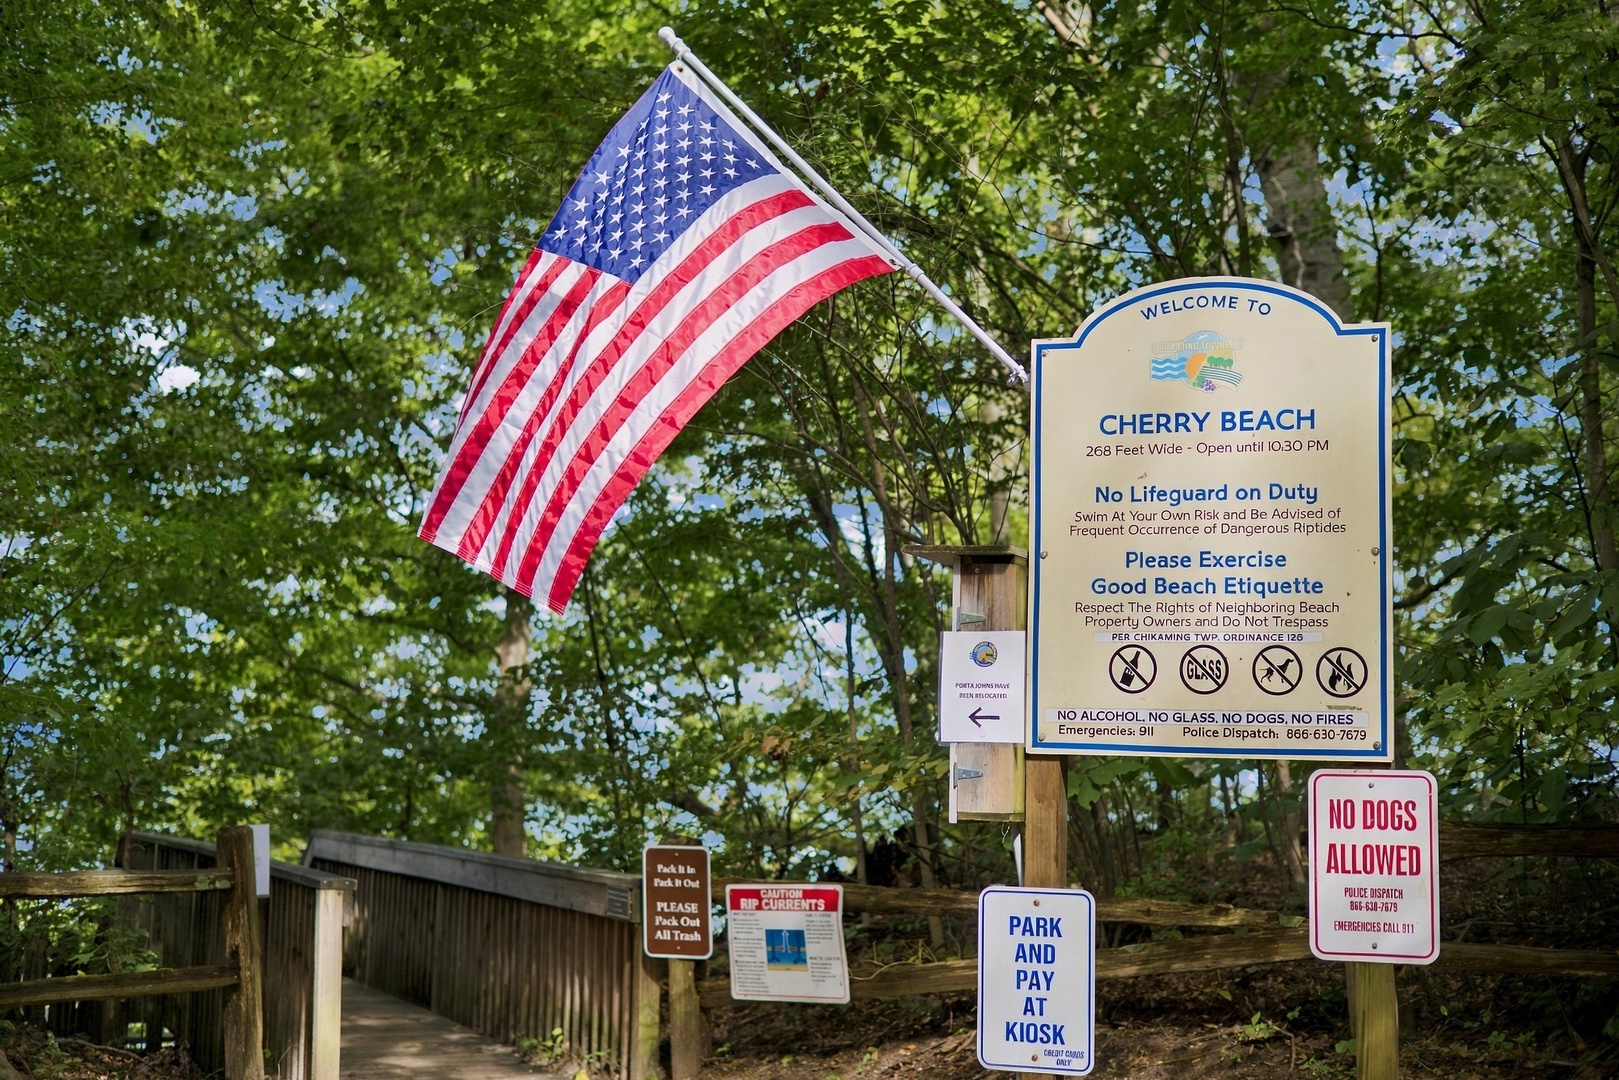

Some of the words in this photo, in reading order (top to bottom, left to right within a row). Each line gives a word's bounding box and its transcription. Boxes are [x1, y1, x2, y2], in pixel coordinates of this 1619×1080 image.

[1140, 295, 1238, 320] WELCOME
[1248, 299, 1272, 316] TO
[1100, 412, 1210, 435] CHERRY
[1221, 409, 1315, 432] BEACH
[1086, 446, 1111, 457] 268
[1116, 445, 1144, 456] Feet
[1148, 443, 1183, 455] Wide
[1197, 443, 1232, 457] Open
[1236, 441, 1264, 453] until
[1307, 440, 1329, 451] PM
[1095, 487, 1123, 503] No
[1131, 485, 1227, 506] Lifeguard
[1235, 488, 1260, 501] on
[1269, 484, 1318, 503] Duty
[1075, 511, 1108, 523] Swim
[1112, 510, 1125, 521] At
[1129, 510, 1158, 521] Your
[1161, 510, 1190, 521] Own
[1194, 509, 1219, 520] Risk
[1223, 509, 1246, 520] and
[1251, 509, 1267, 519] Be
[1272, 508, 1324, 519] Advised
[1328, 508, 1341, 518] of
[1070, 525, 1124, 538] Frequent
[1128, 524, 1199, 535] Occurrence
[1205, 523, 1217, 534] of
[1221, 523, 1289, 537] Dangerous
[1294, 522, 1346, 535] Riptides
[1125, 551, 1192, 569] Please
[1199, 550, 1287, 568] Exercise
[1091, 579, 1146, 594] Good
[1154, 578, 1216, 594] Beach
[1224, 577, 1324, 599] Etiquette
[1076, 602, 1124, 615] Respect
[1128, 602, 1152, 613] The
[1156, 602, 1195, 615] Rights
[1199, 602, 1212, 613] of
[1216, 602, 1295, 616] Neighboring
[1300, 602, 1340, 613] Beach
[1085, 616, 1139, 630] Property
[1143, 616, 1192, 627] Owners
[1195, 616, 1218, 627] and
[1222, 616, 1241, 627] Do
[1244, 616, 1268, 627] Not
[1272, 616, 1329, 630] Trespass
[1111, 633, 1130, 641] PER
[1134, 633, 1191, 642] CHIKAMING
[1194, 633, 1220, 642] TWP.
[1223, 633, 1283, 642] ORDINANCE
[1287, 633, 1303, 642] 126
[1187, 660, 1221, 680] GLASS
[1057, 710, 1076, 721] NO
[1149, 712, 1168, 722] NO
[1222, 713, 1242, 723] NO
[1292, 714, 1312, 724] NO
[1317, 714, 1354, 725] FIRES
[1059, 724, 1136, 737] Emergencies:
[1139, 726, 1154, 736] 911
[1182, 727, 1218, 738] Police
[1223, 727, 1280, 741] Dispatch:
[1286, 729, 1367, 740] 866-630-7679
[1329, 799, 1355, 829] NO
[1362, 799, 1417, 831] DOGS
[1326, 843, 1421, 876] ALLOWED
[657, 864, 677, 874] Pack
[678, 865, 685, 874] It
[686, 865, 695, 874] In
[654, 878, 673, 887] Pack
[675, 879, 682, 887] It
[684, 880, 699, 888] Out
[760, 890, 803, 898] CAUTION
[1344, 887, 1368, 898] POLICE
[1370, 888, 1403, 899] DISPATCH
[657, 902, 698, 913] PLEASE
[740, 898, 759, 910] RIP
[762, 899, 825, 911] CURRENTS
[1350, 901, 1398, 912] 866-630-7679
[655, 916, 678, 926] Pack
[680, 917, 700, 927] Out
[1009, 916, 1062, 938] PARK
[1334, 921, 1381, 932] EMERGENCIES
[1383, 922, 1400, 933] CALL
[1402, 924, 1414, 933] 911
[654, 930, 671, 940] All
[672, 931, 701, 941] Trash
[1015, 943, 1056, 964] AND
[1016, 970, 1055, 991] PAY
[1023, 997, 1047, 1016] AT
[1005, 1022, 1065, 1045] KIOSK
[1044, 1049, 1064, 1057] CREDIT
